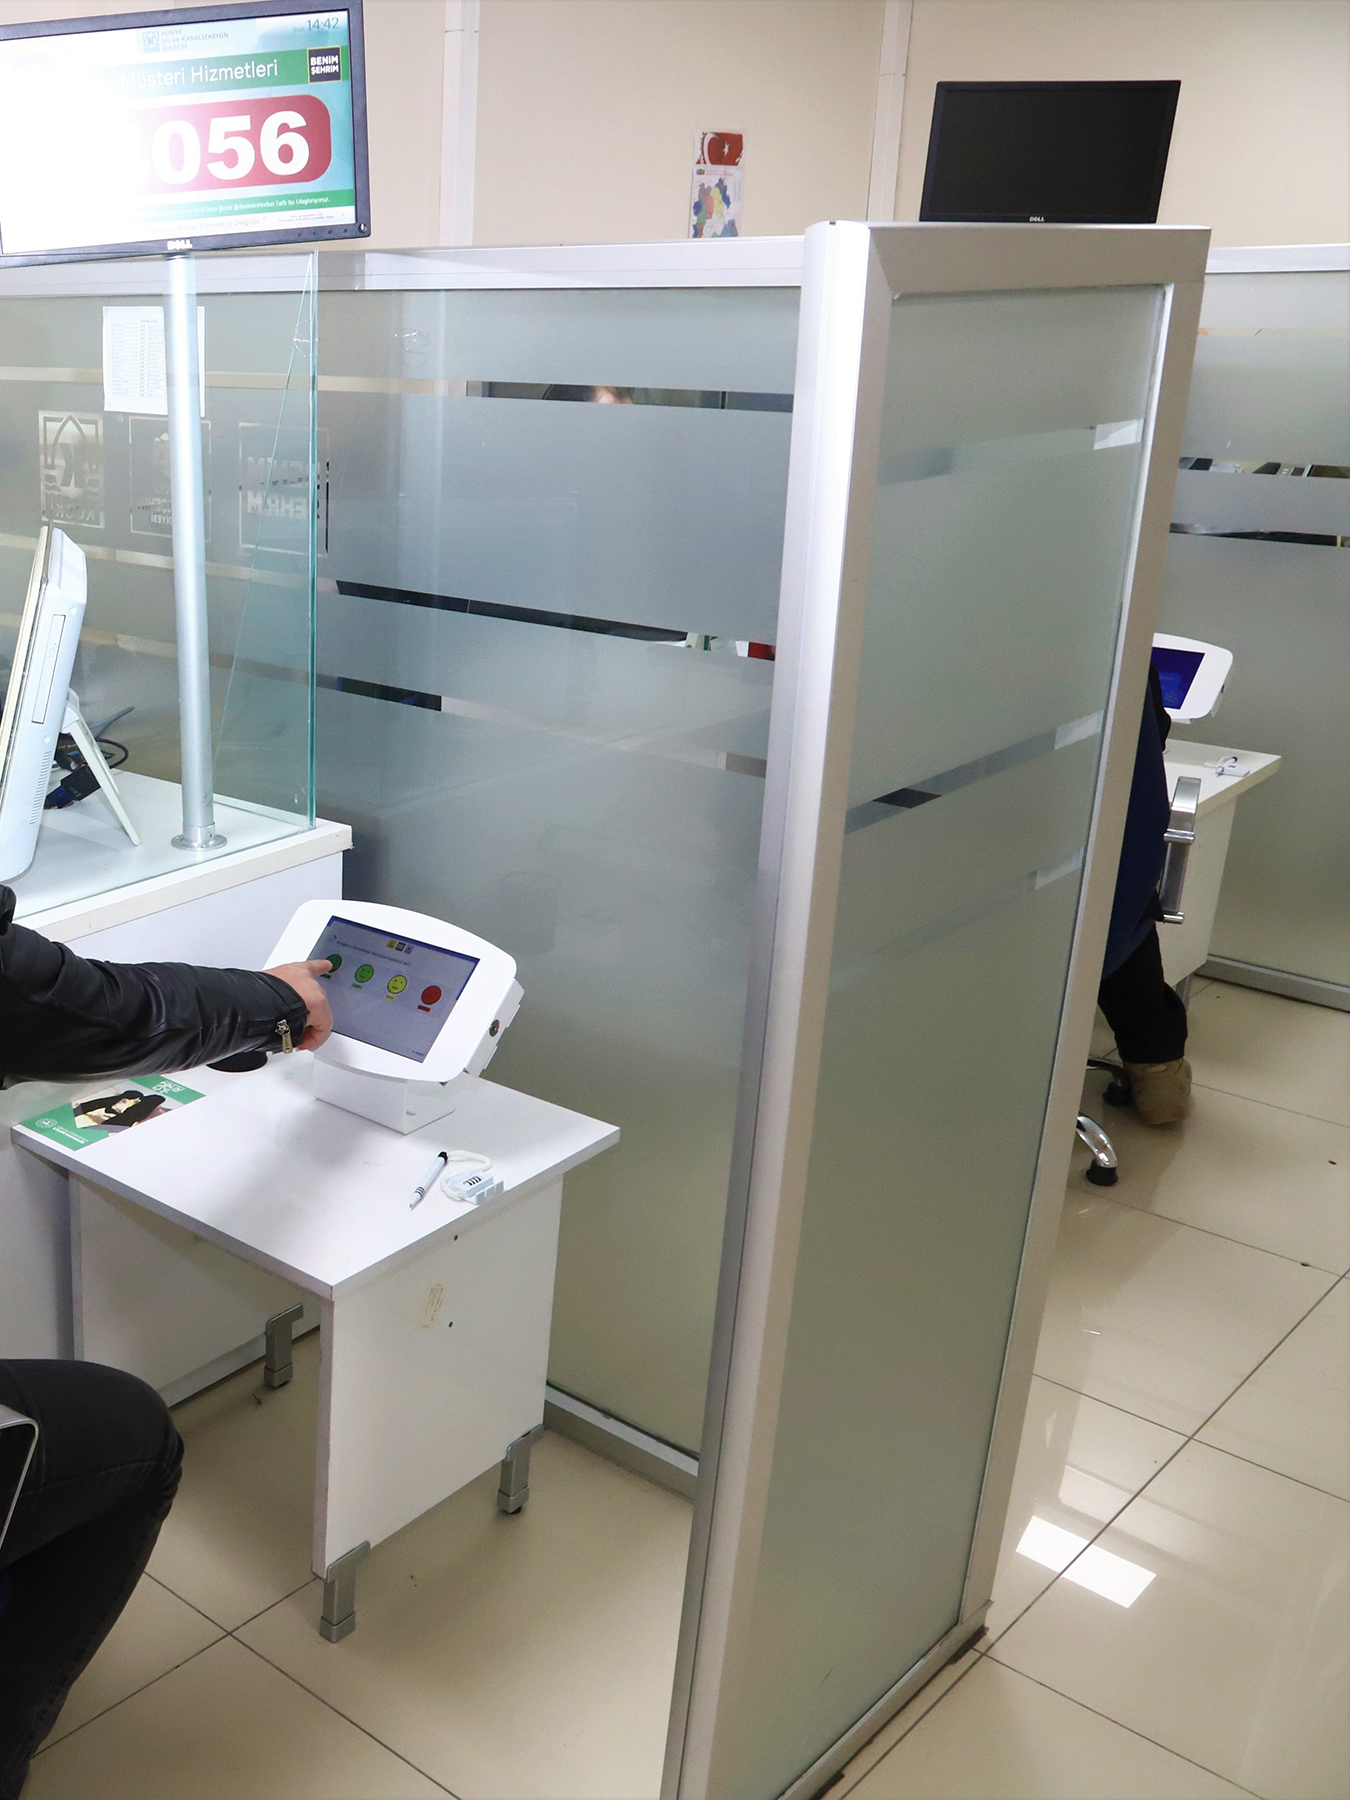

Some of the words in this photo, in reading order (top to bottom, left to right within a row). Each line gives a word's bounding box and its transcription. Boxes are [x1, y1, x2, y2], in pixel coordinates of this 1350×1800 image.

[307, 17, 340, 31] 14:42
[310, 55, 339, 66] BENİM
[120, 66, 185, 90] Müşteri
[191, 59, 279, 84] Hizmetleri
[310, 64, 340, 76] ŞEHRİM
